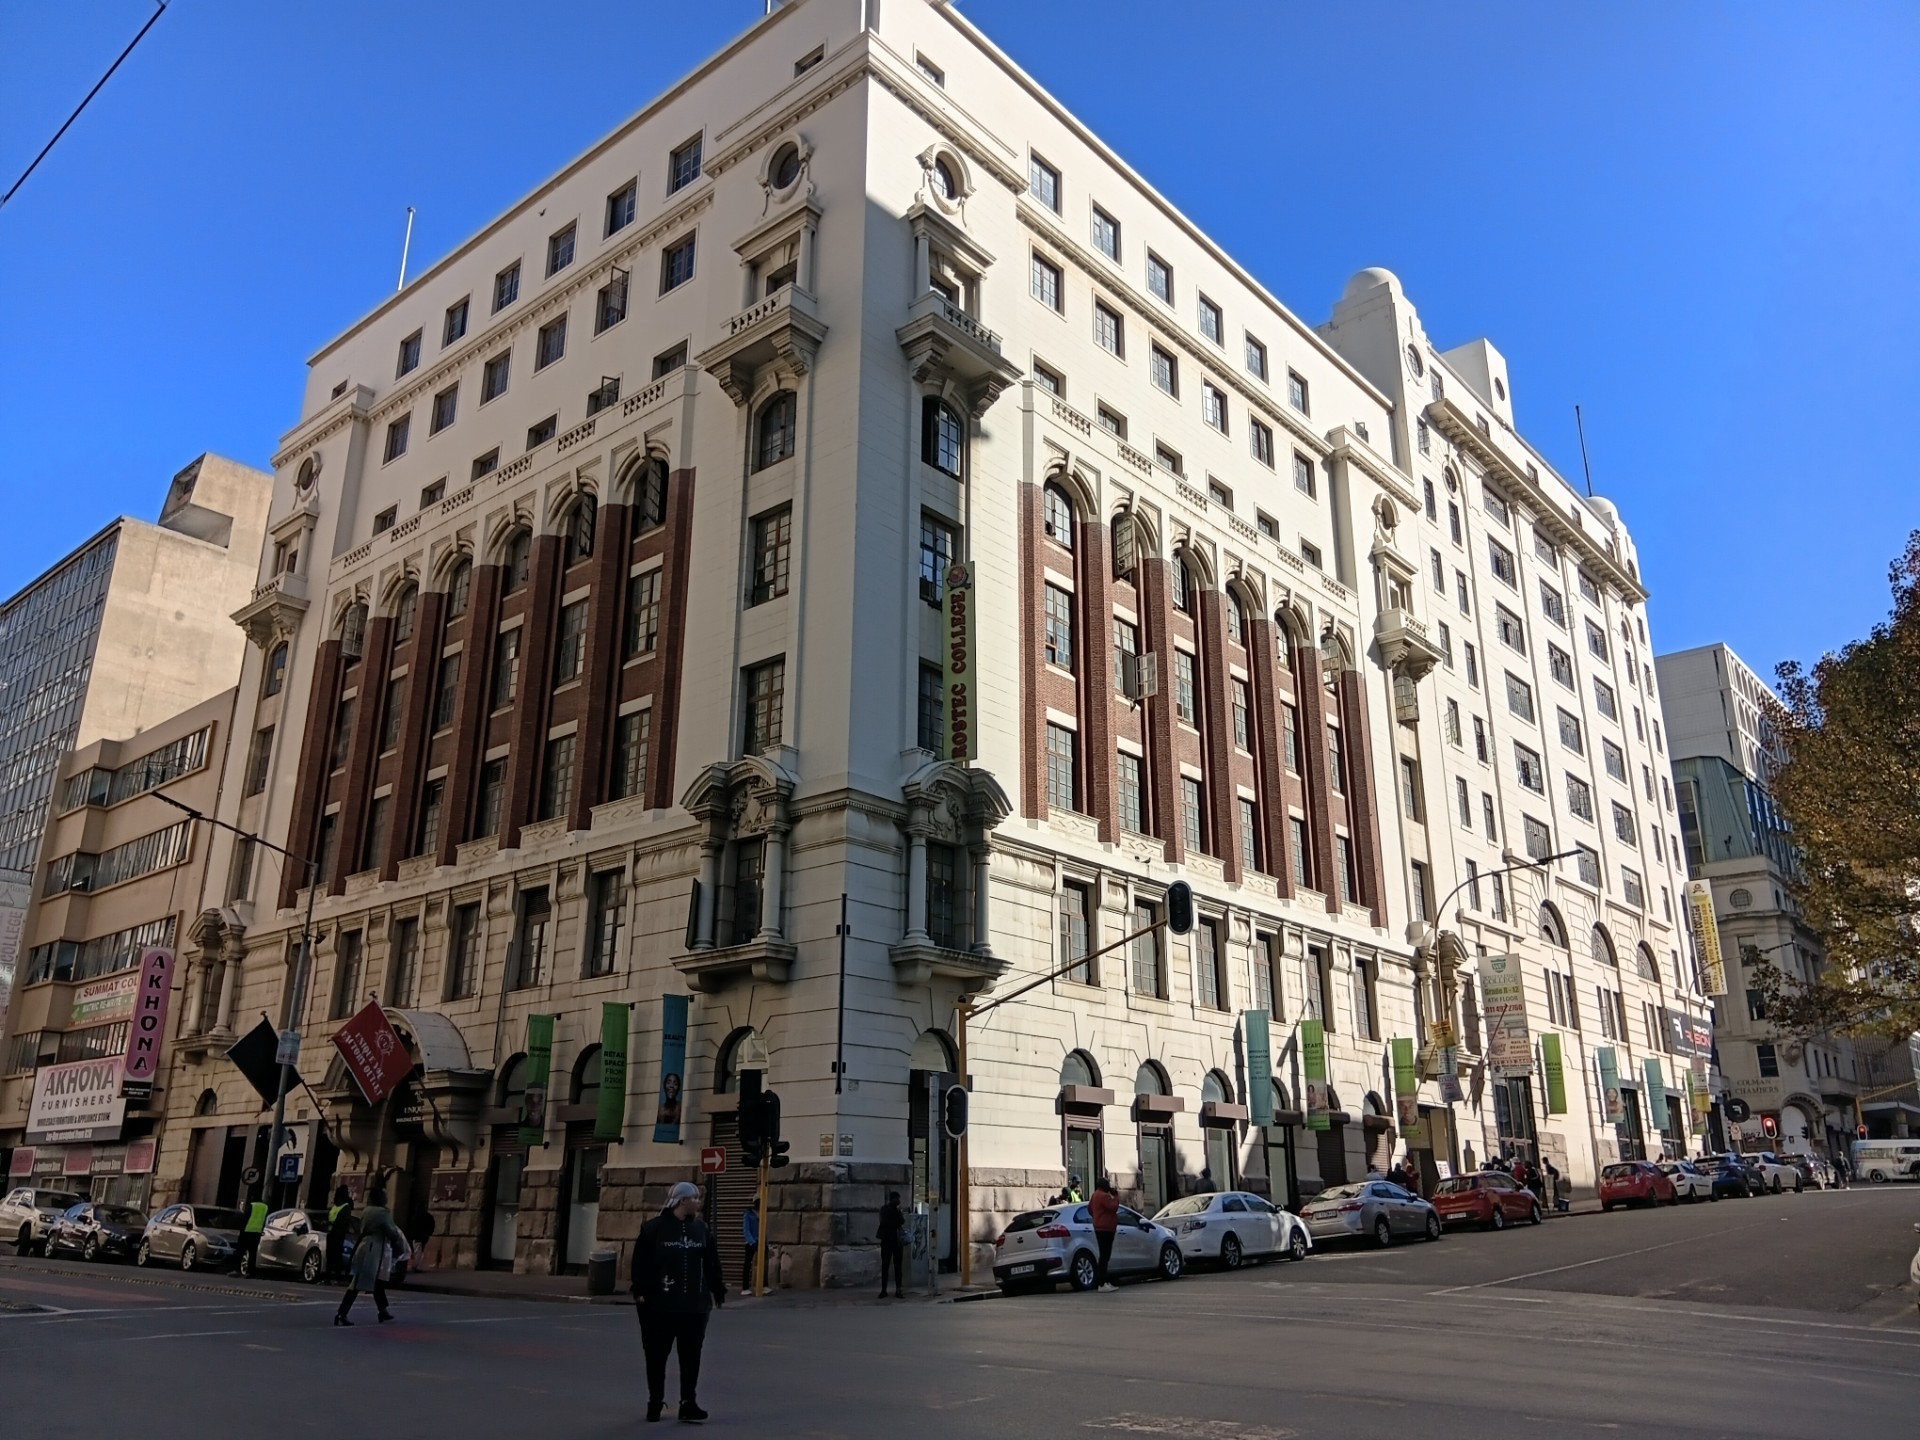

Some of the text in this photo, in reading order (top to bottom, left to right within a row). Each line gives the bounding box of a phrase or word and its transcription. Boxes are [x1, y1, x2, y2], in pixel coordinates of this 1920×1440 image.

[950, 590, 968, 760] ROSTEC COLLEGE
[83, 980, 120, 998] SUMMAT
[133, 955, 166, 1071] AKHONA
[604, 1050, 626, 1058] RETAIL
[604, 1059, 625, 1067] SPACE
[44, 1063, 114, 1097] AKHONA
[1734, 1087, 1779, 1095] CHAMBERS
[41, 1094, 112, 1111] FURNISHERS
[285, 1158, 295, 1171] P
